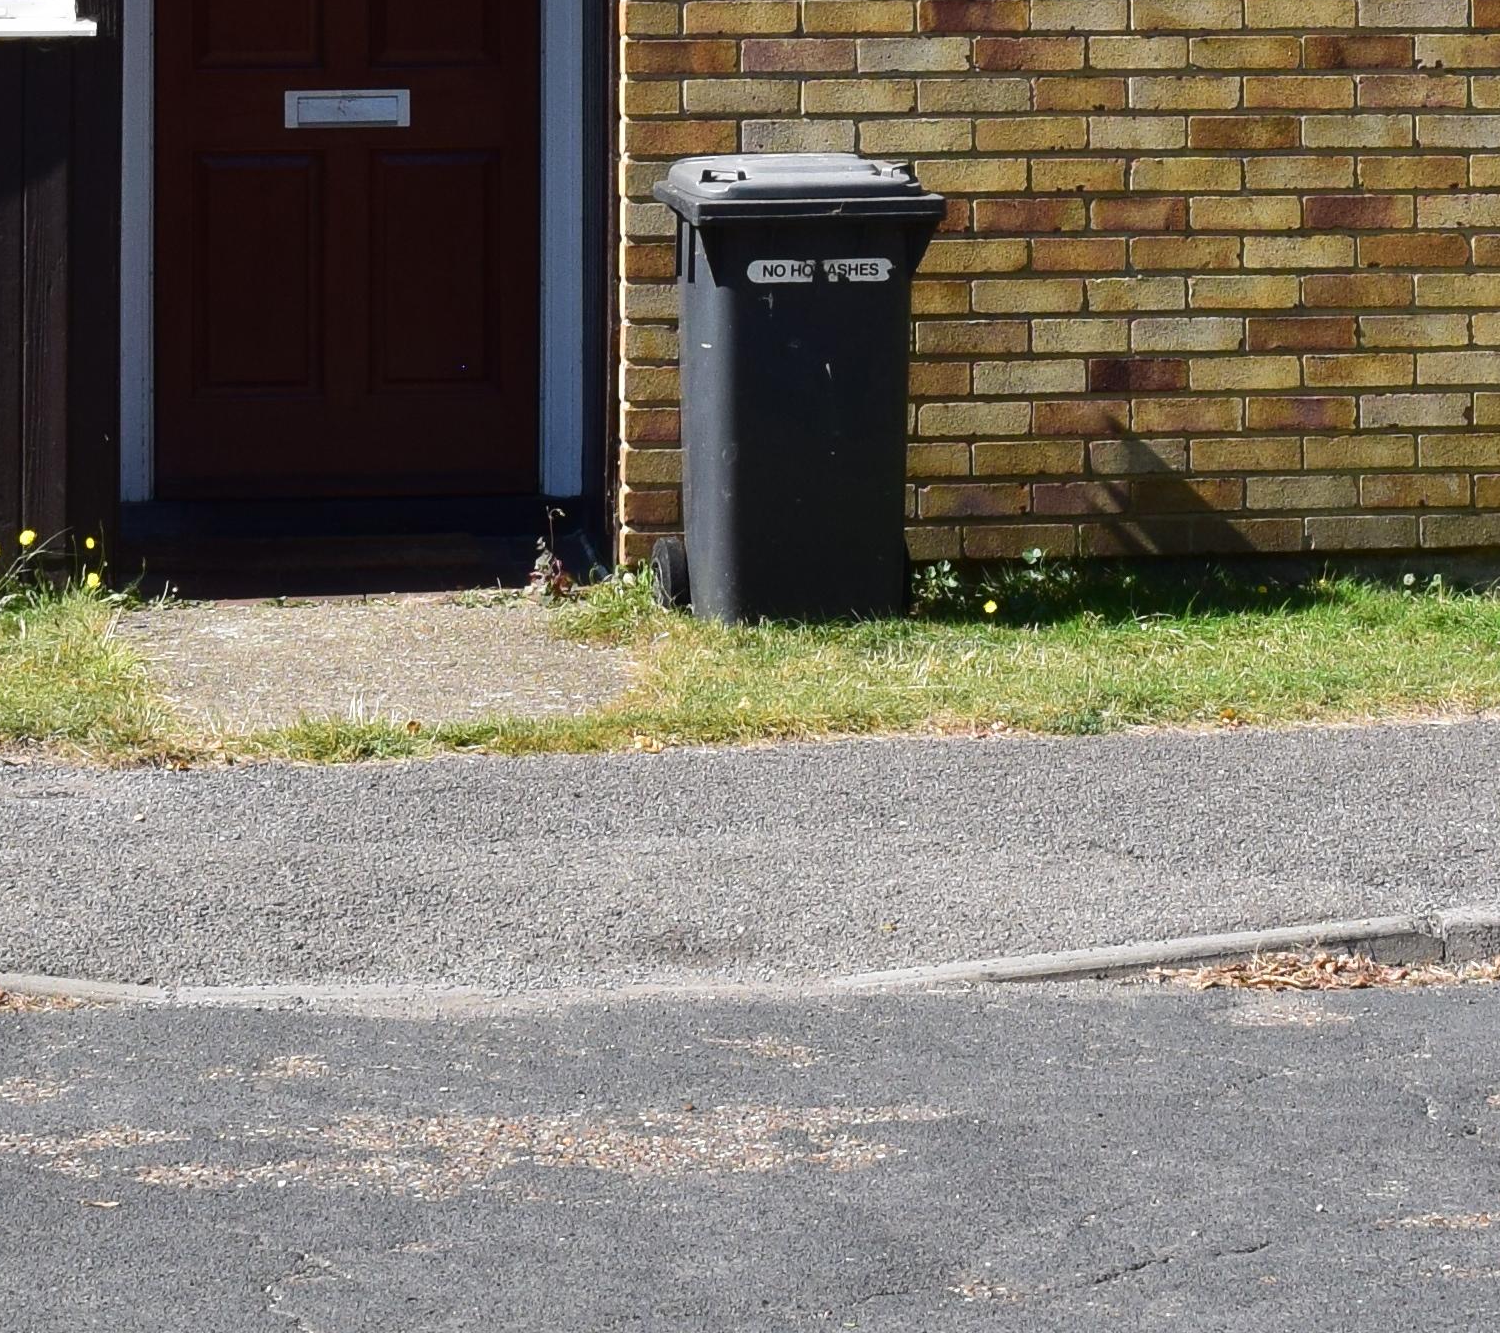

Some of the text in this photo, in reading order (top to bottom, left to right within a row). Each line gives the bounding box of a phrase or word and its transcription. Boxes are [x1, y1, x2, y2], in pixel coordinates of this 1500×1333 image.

[762, 263, 879, 279] NO HO ASHES
